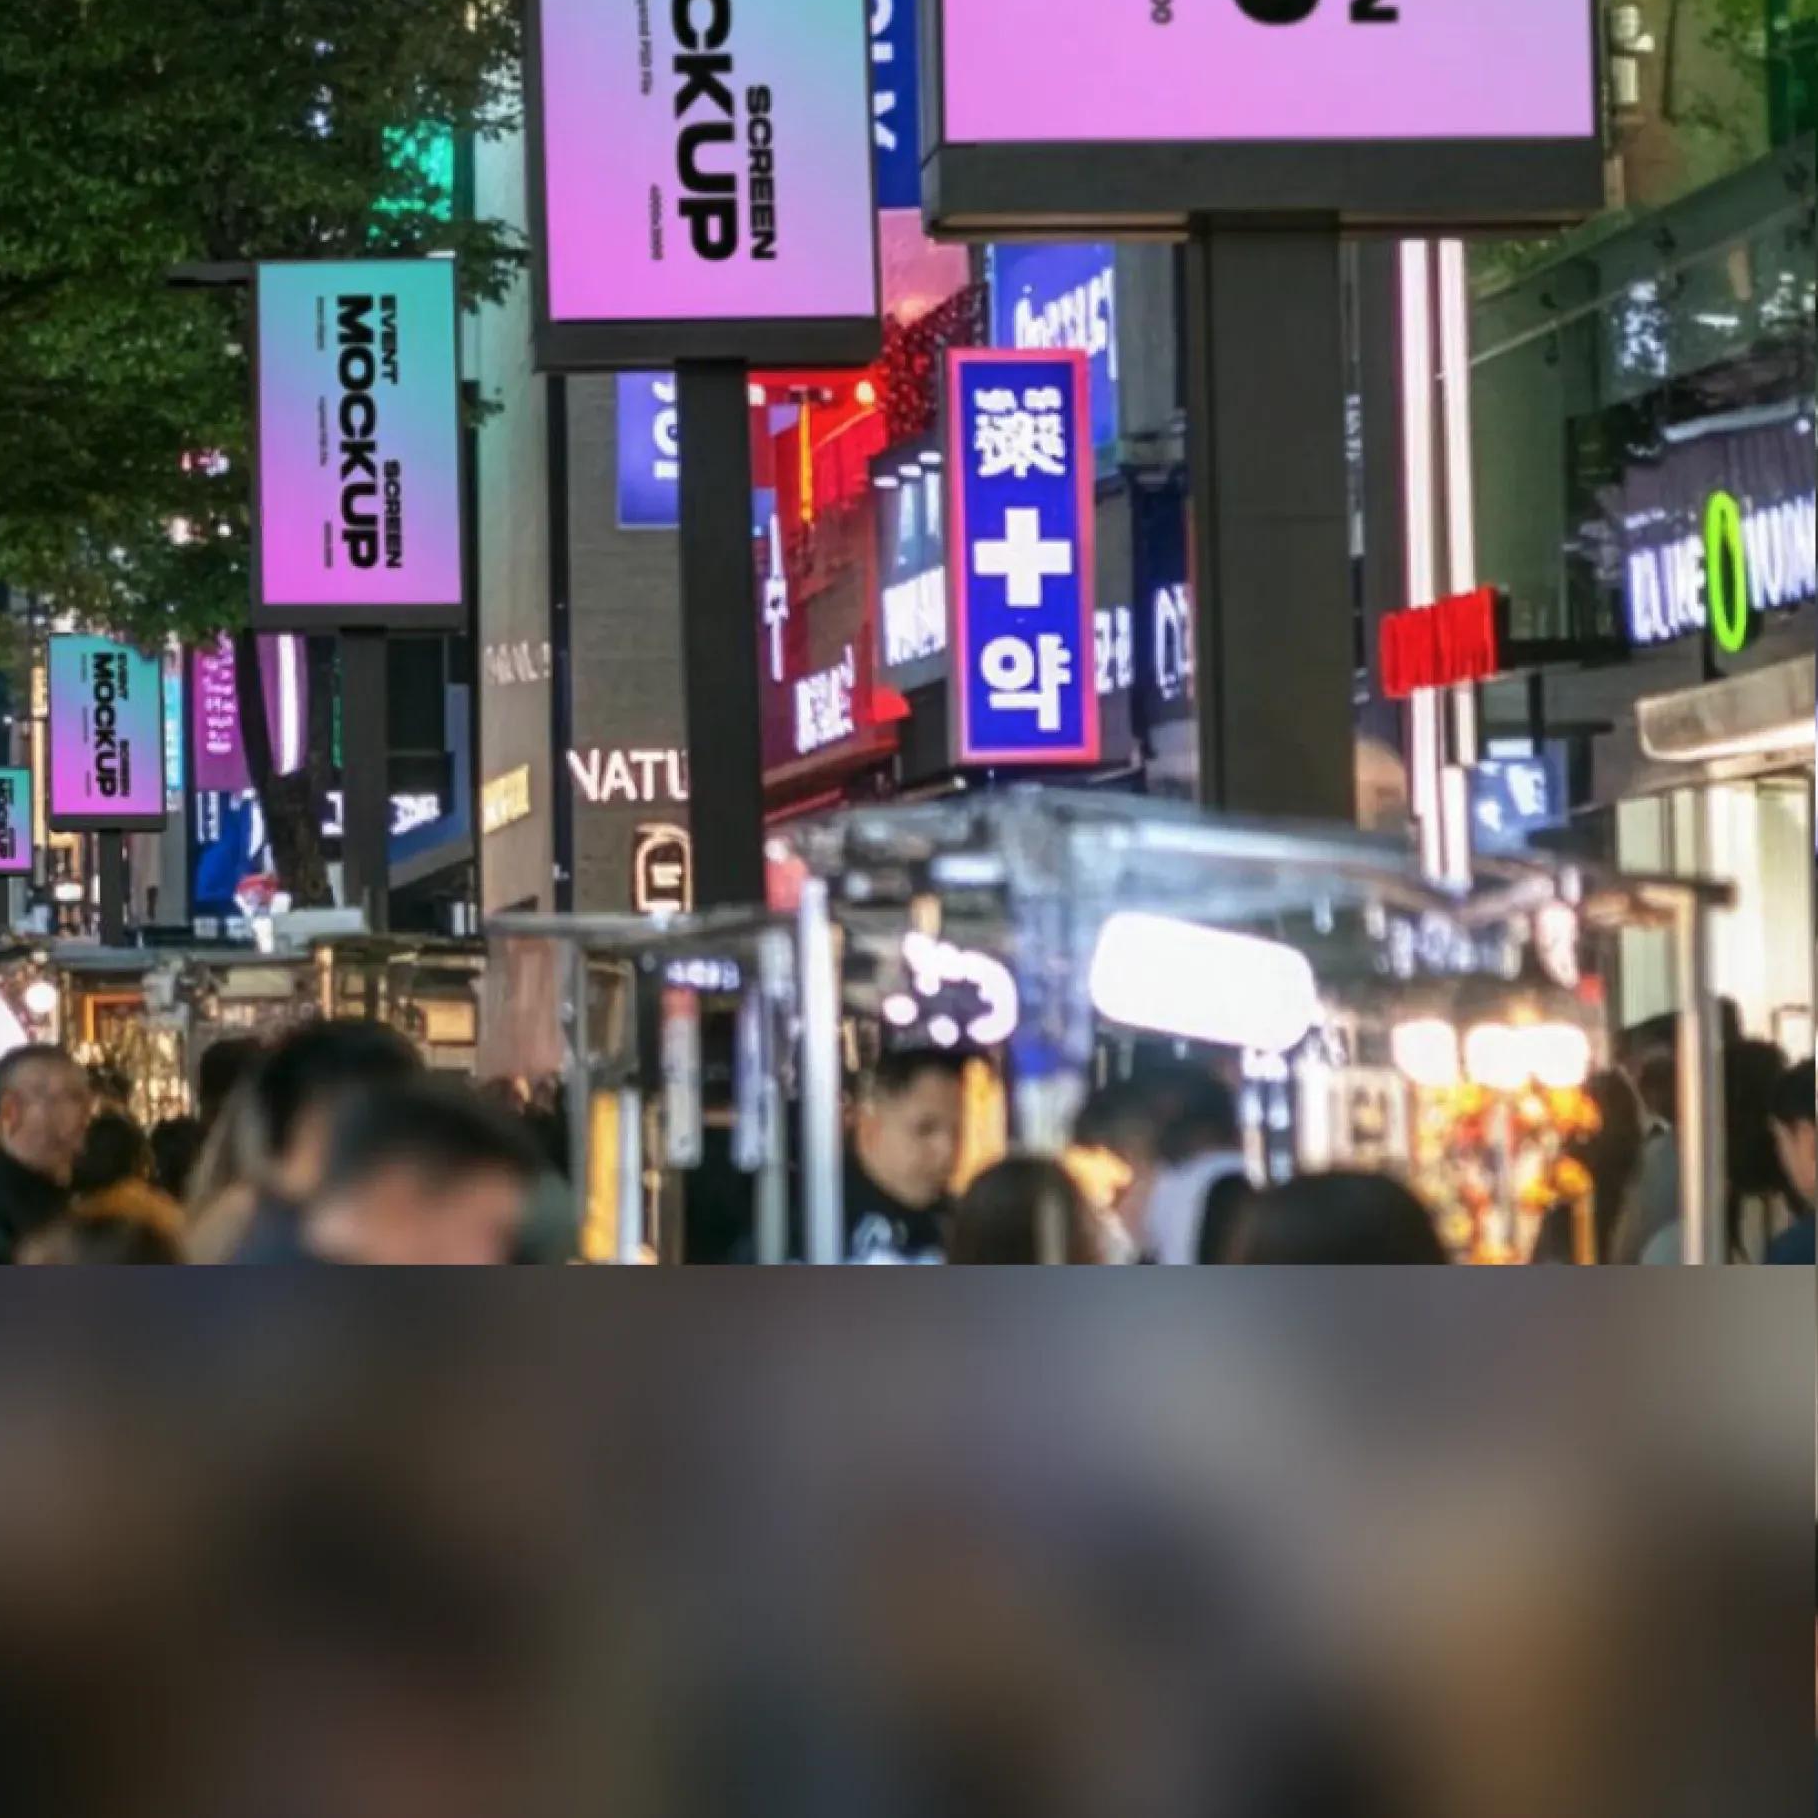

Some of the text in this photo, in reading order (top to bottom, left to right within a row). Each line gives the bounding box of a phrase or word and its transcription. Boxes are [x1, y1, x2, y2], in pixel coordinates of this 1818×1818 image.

[745, 84, 776, 261] SCREEN
[337, 294, 378, 569] MOCKUP
[380, 294, 403, 569] EVENT SCREEN
[92, 652, 116, 797] MOCKUP
[981, 635, 1071, 731] 약
